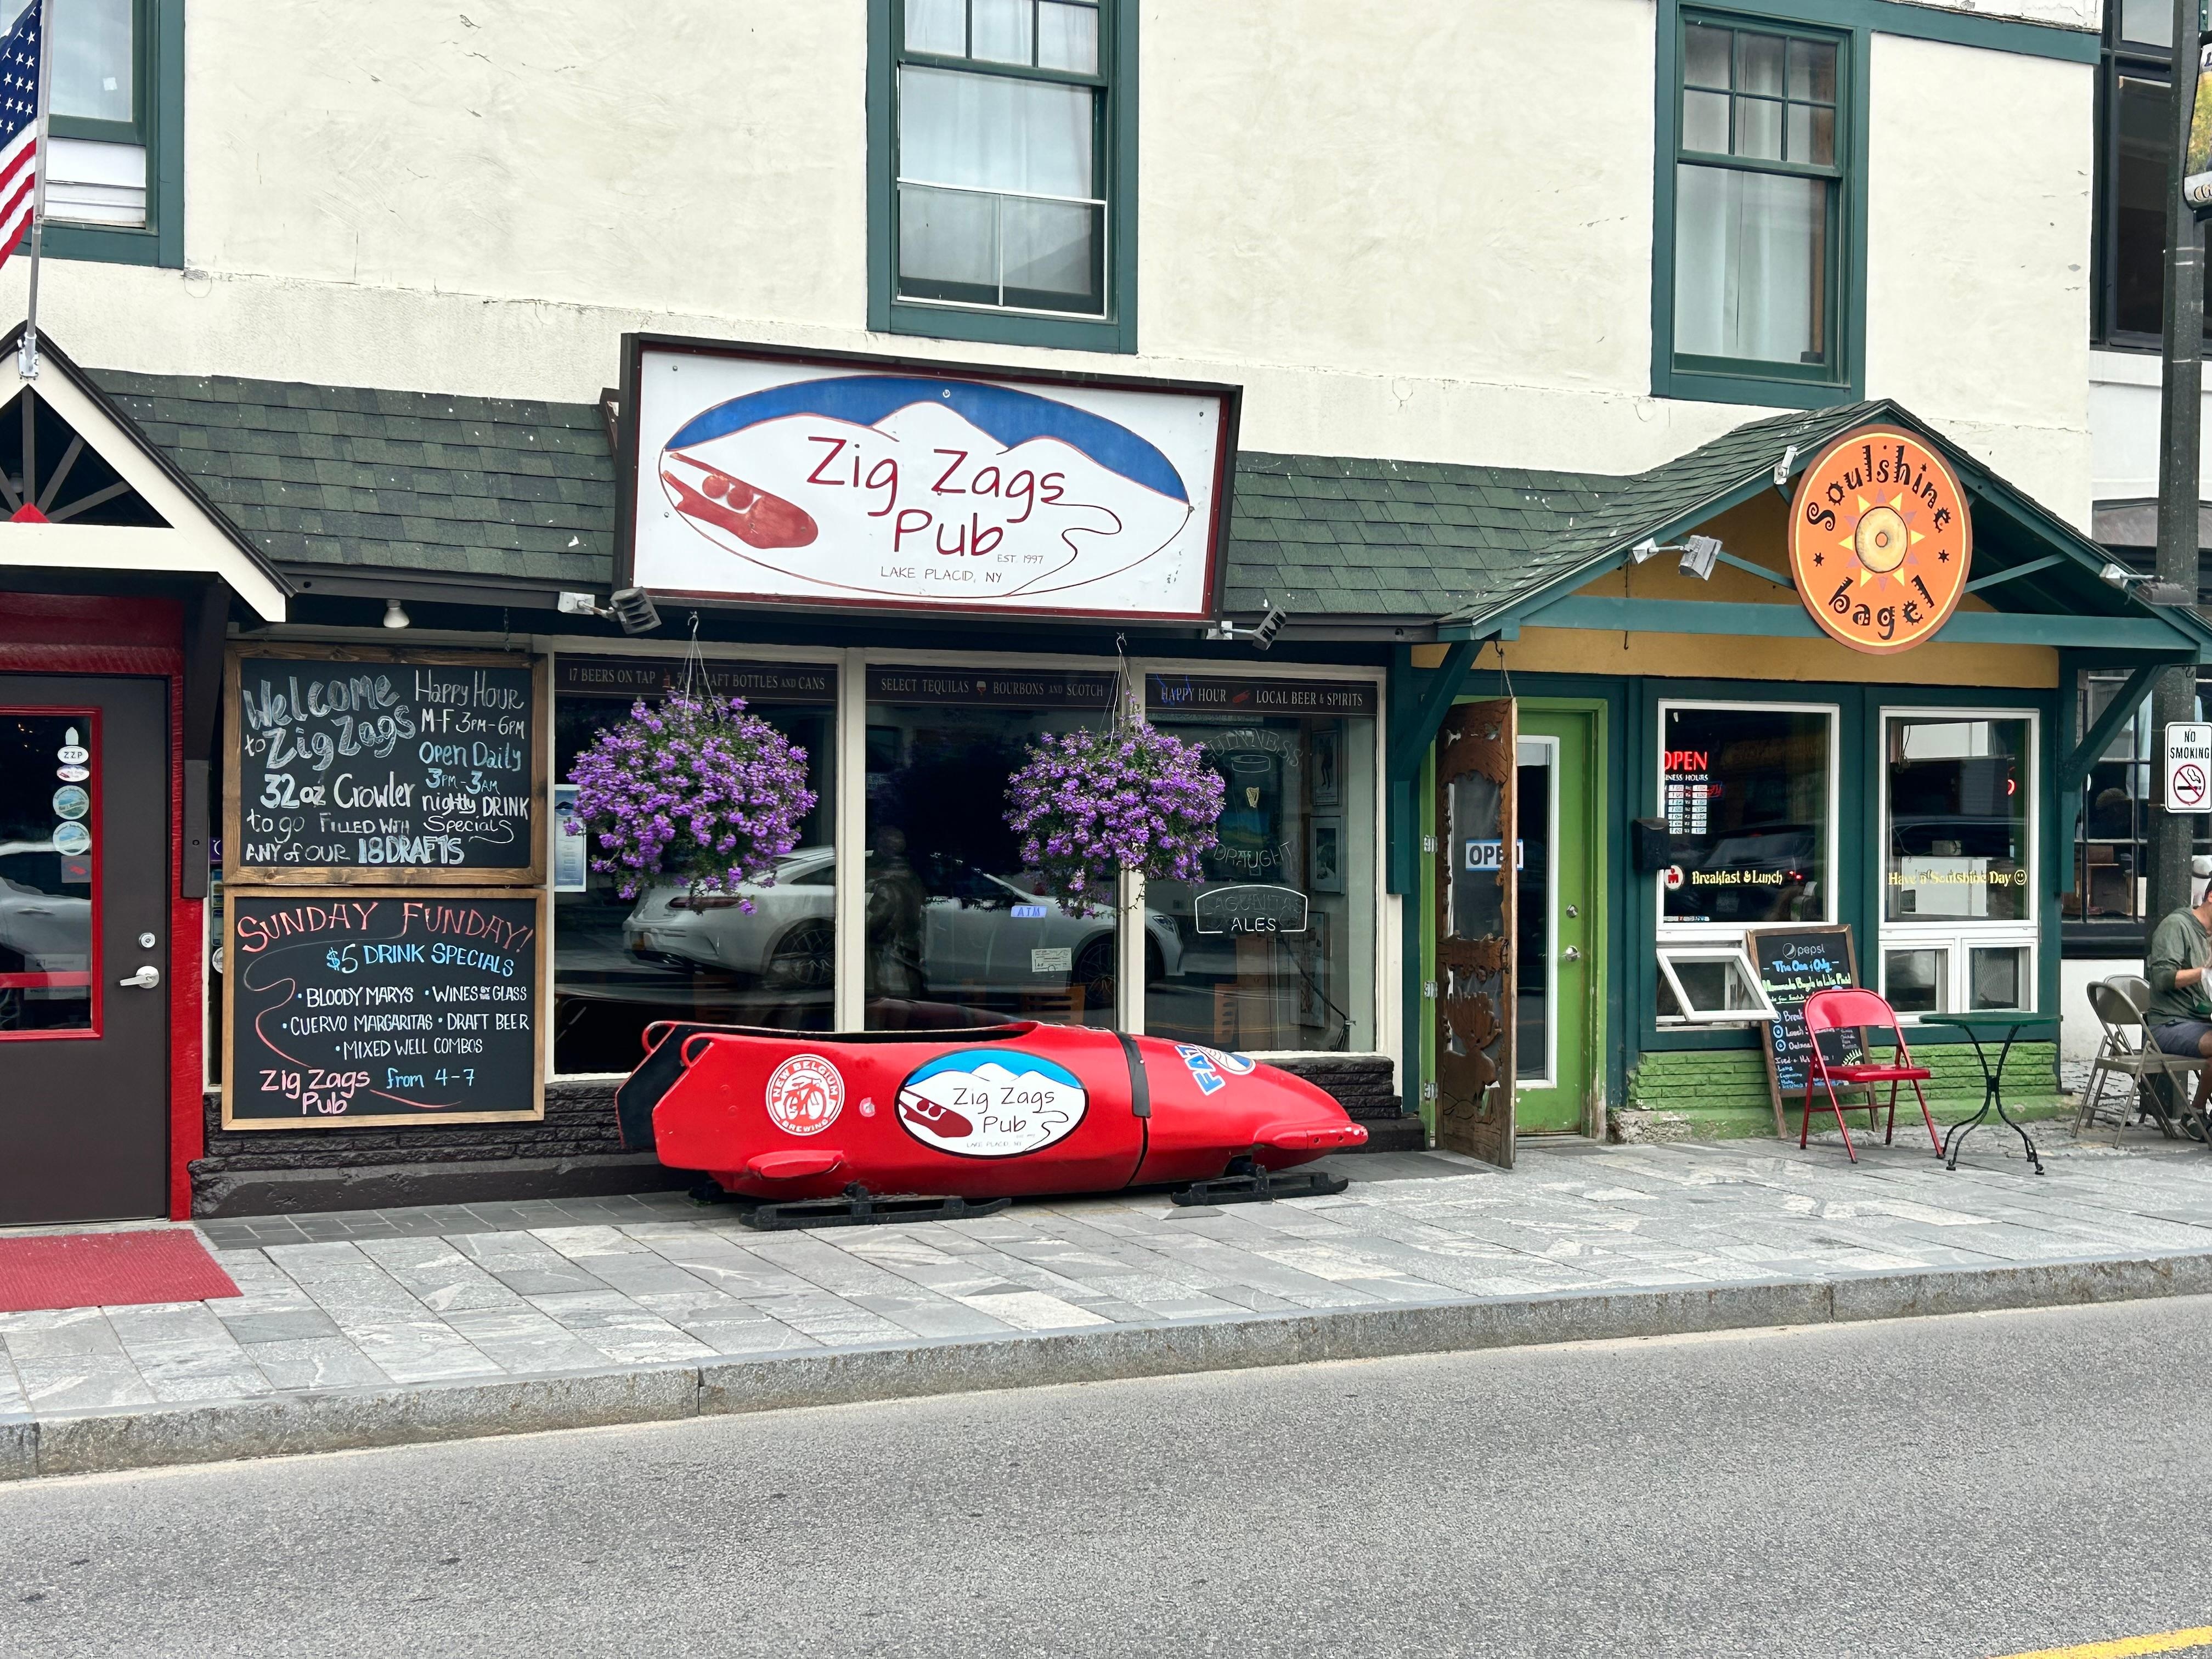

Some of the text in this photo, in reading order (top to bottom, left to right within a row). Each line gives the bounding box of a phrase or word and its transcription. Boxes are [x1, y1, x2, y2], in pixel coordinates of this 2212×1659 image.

[806, 436, 1065, 523] Zig Zags
[1807, 444, 1951, 533] Soulshine
[894, 509, 1003, 557] Pub
[1023, 555, 1043, 564] 1997
[881, 566, 916, 578] LAKE
[985, 572, 1002, 583] NY
[1829, 574, 1934, 640] bagel
[568, 667, 656, 685] 17 BEERS ON TAP
[697, 673, 730, 687] CRAFT
[732, 674, 778, 689] BOTTLES
[780, 678, 796, 689] AND
[798, 676, 825, 690] CANS
[881, 678, 969, 695] SELECT TEQUILAS
[992, 681, 1104, 697] BOURBONS AND SCOTCH
[1161, 686, 1226, 702] HAPPY HOUR
[1256, 690, 1363, 707] LOCAL BEER & SPIRITS
[242, 675, 400, 730] Welcome
[421, 708, 455, 733] M-F
[244, 734, 266, 757] to
[2184, 731, 2196, 743] NO
[472, 741, 521, 772] Daily
[2170, 747, 2209, 759] SMOKING
[333, 771, 416, 809] Crowler
[482, 796, 530, 820] DRINK
[246, 808, 274, 833] to
[274, 816, 305, 844] go
[245, 842, 281, 862] ANY
[283, 842, 304, 862] of
[304, 844, 351, 862] OUR
[1213, 840, 1292, 868] DRAUGHT
[1468, 845, 1521, 866] OPE
[1692, 870, 1783, 885] Breakfast & Lunch
[1888, 871, 1917, 885] Have
[1989, 870, 2012, 887] Day
[1017, 906, 1042, 917] ATM
[237, 901, 534, 953] SUNDAY FUNDAY!
[1231, 917, 1277, 932] ALES
[326, 942, 515, 977] $5 DRINK SPECIALS
[306, 986, 414, 1008] BLOODY MARYS
[432, 985, 478, 1003] WINES
[492, 985, 527, 1001] GLASS
[290, 1014, 433, 1036] CUERVO MARGARITAS
[447, 1012, 530, 1030] DRAFT BEER
[343, 1037, 483, 1060] MIXED WELL COMBOS
[259, 1068, 371, 1099] Zig Zags
[386, 1067, 425, 1090] from
[772, 1060, 839, 1097] NEW BELGIUM
[302, 1091, 348, 1115] Pub
[952, 1087, 1055, 1115] Zig Zags
[781, 1118, 829, 1133] BREWING
[983, 1115, 1026, 1133] Pub
